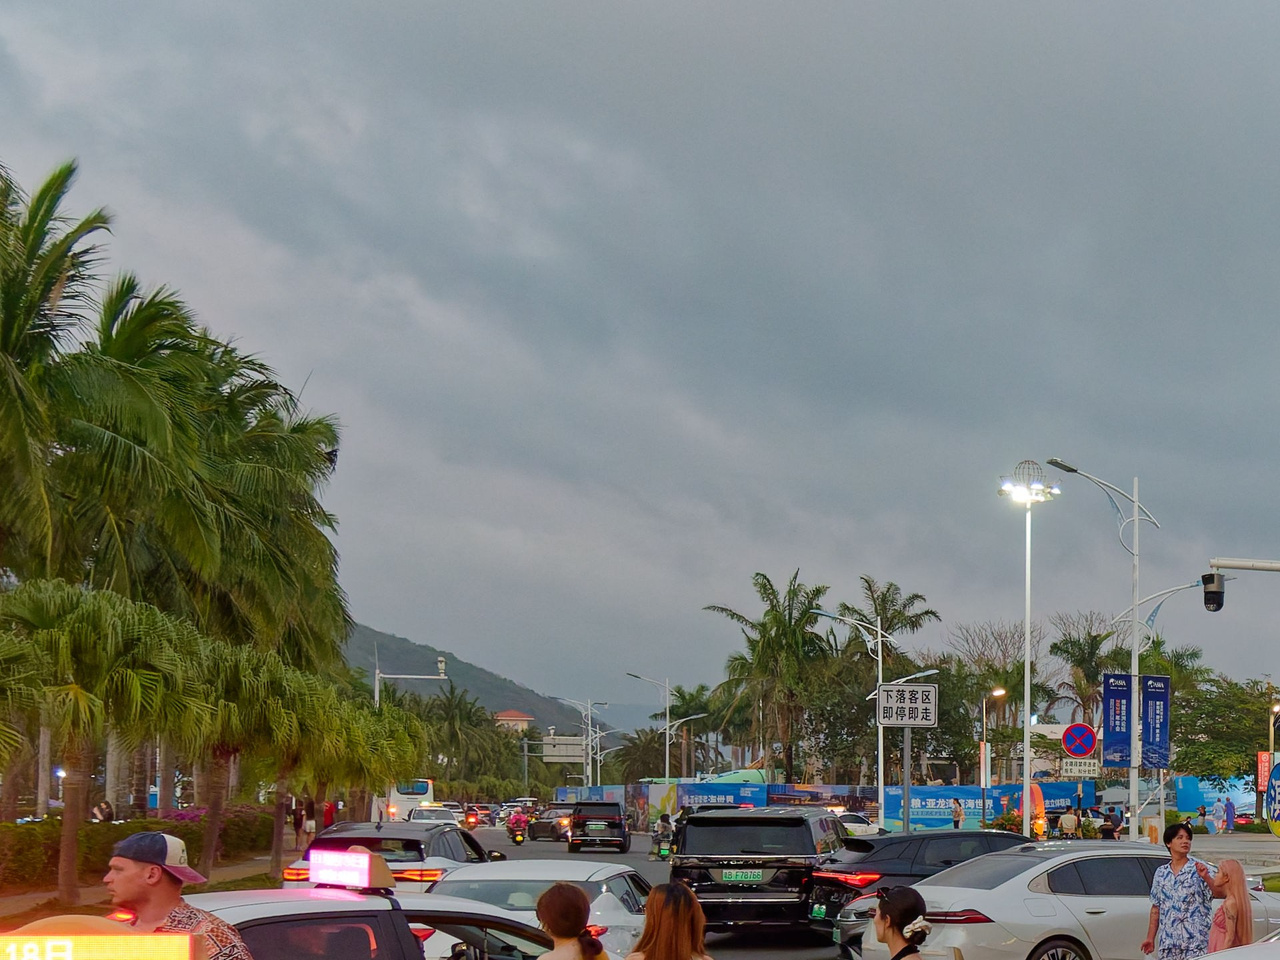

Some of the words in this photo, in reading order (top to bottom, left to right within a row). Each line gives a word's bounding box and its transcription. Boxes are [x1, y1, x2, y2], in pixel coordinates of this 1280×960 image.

[882, 689, 932, 704] 下落客区
[882, 706, 932, 721] 即停即走
